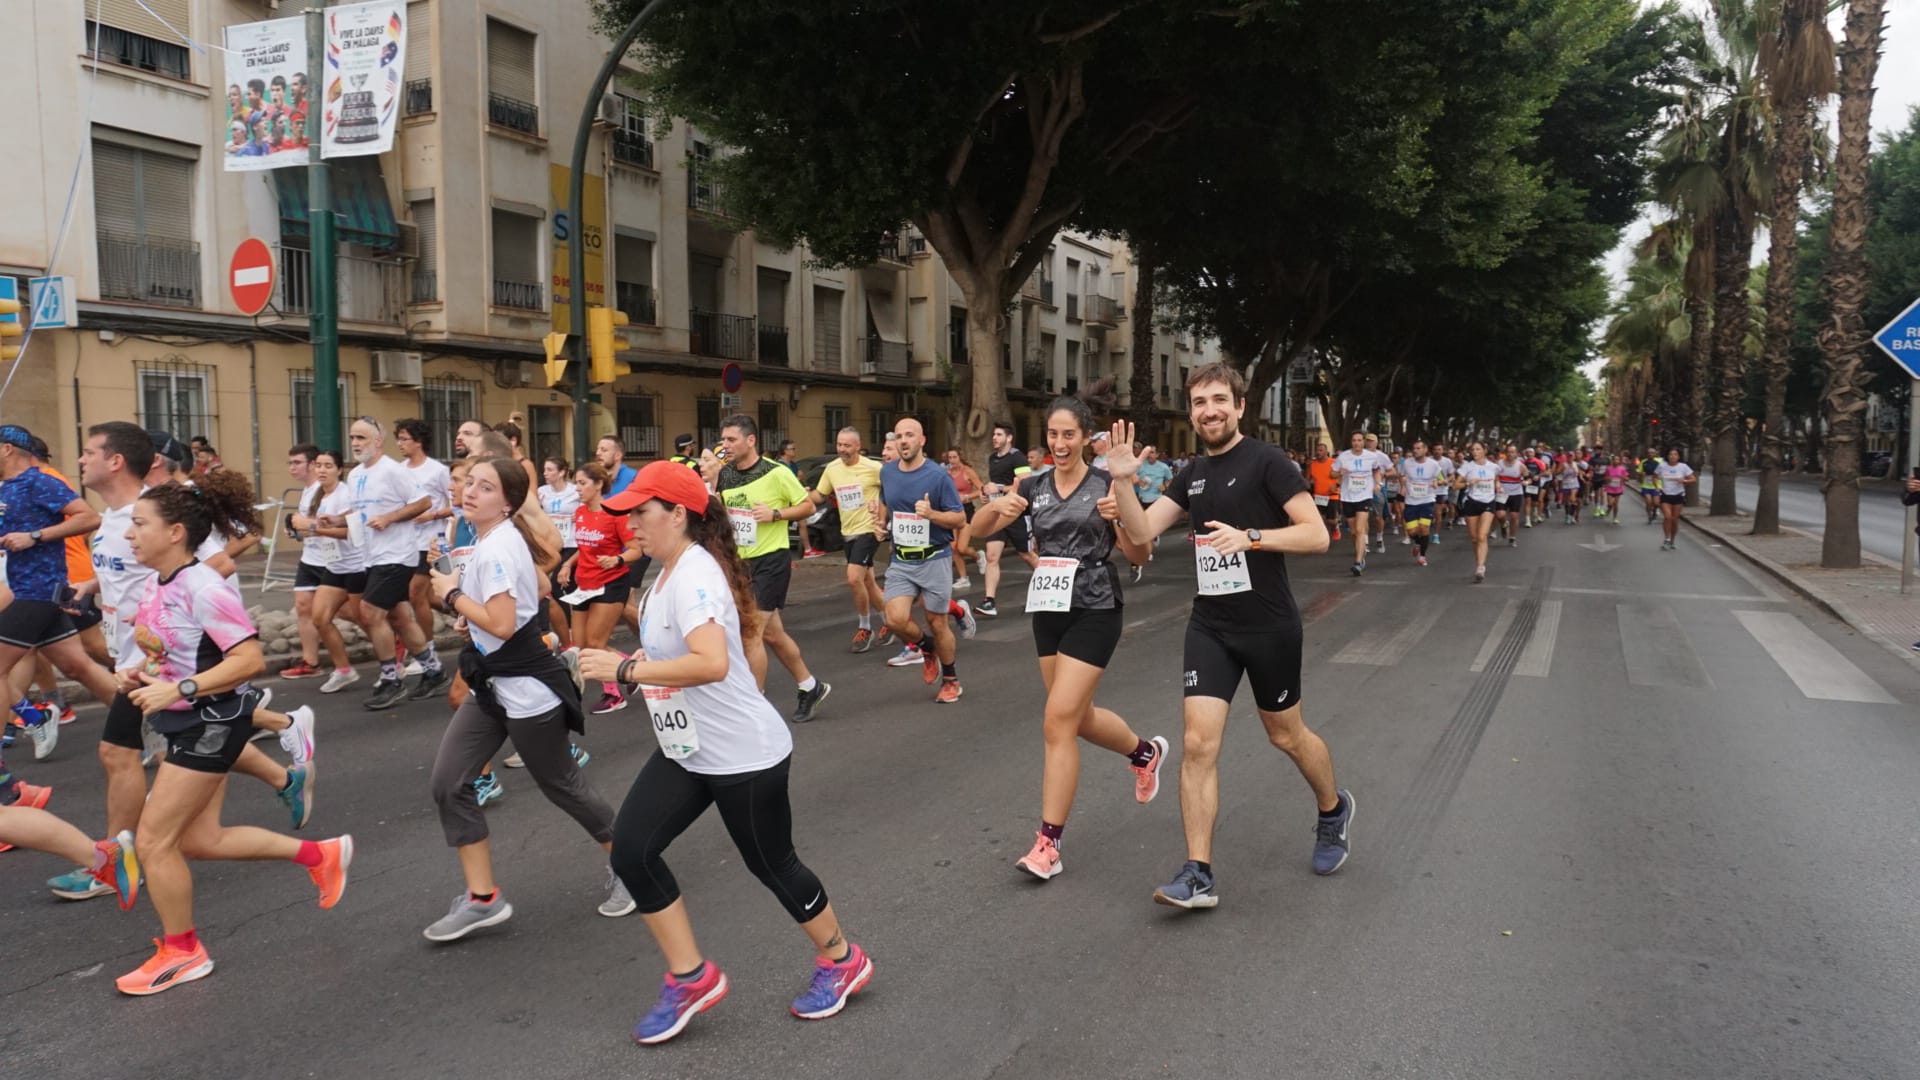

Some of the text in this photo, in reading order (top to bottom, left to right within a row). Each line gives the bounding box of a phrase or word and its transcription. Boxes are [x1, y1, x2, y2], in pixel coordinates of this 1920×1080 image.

[898, 524, 924, 535] 9182
[1199, 553, 1242, 573] 13244
[1032, 576, 1070, 591] 13245
[654, 709, 688, 732] 040
